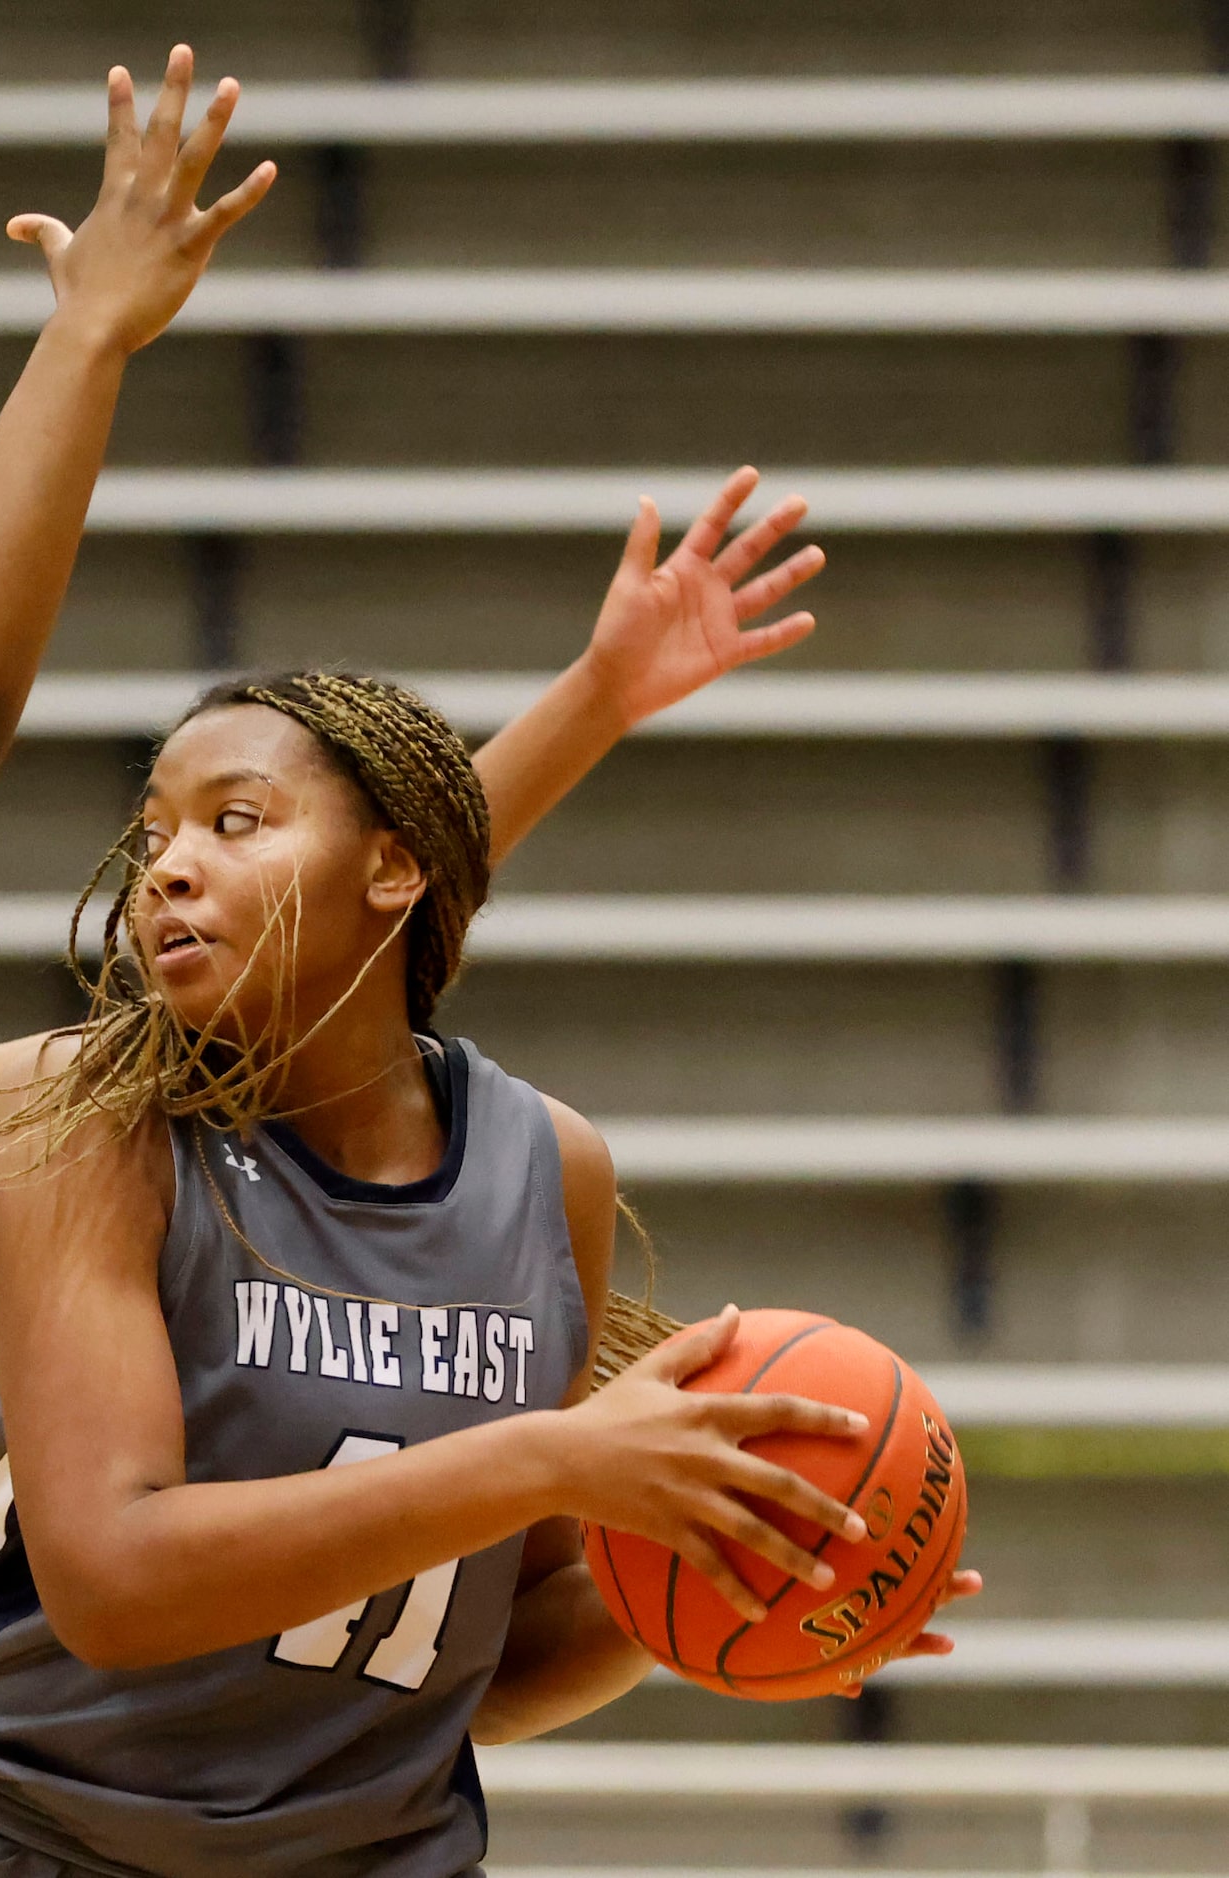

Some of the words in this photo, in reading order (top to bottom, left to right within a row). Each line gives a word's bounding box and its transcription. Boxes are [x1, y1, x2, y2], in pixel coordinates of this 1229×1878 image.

[233, 1279, 403, 1389] WYLIE
[419, 1305, 535, 1406] EAST
[799, 1410, 956, 1660] SPALDING
